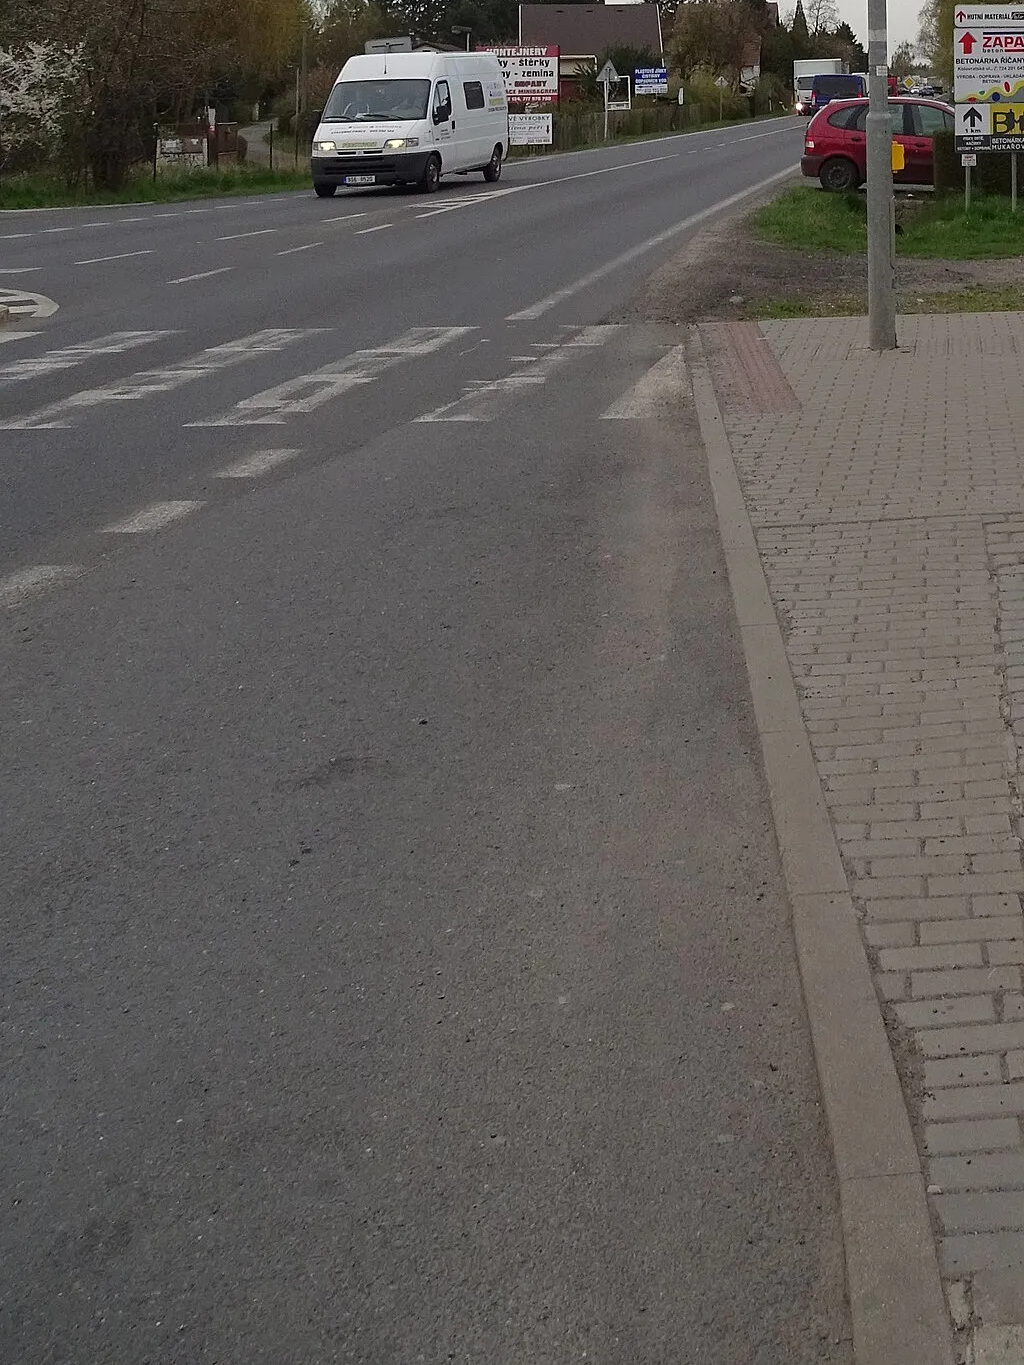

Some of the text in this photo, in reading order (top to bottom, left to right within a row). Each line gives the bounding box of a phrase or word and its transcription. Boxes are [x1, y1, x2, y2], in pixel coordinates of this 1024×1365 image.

[983, 37, 1024, 47] ZAPA
[519, 58, 550, 67] štěrky
[522, 69, 554, 77] zemina
